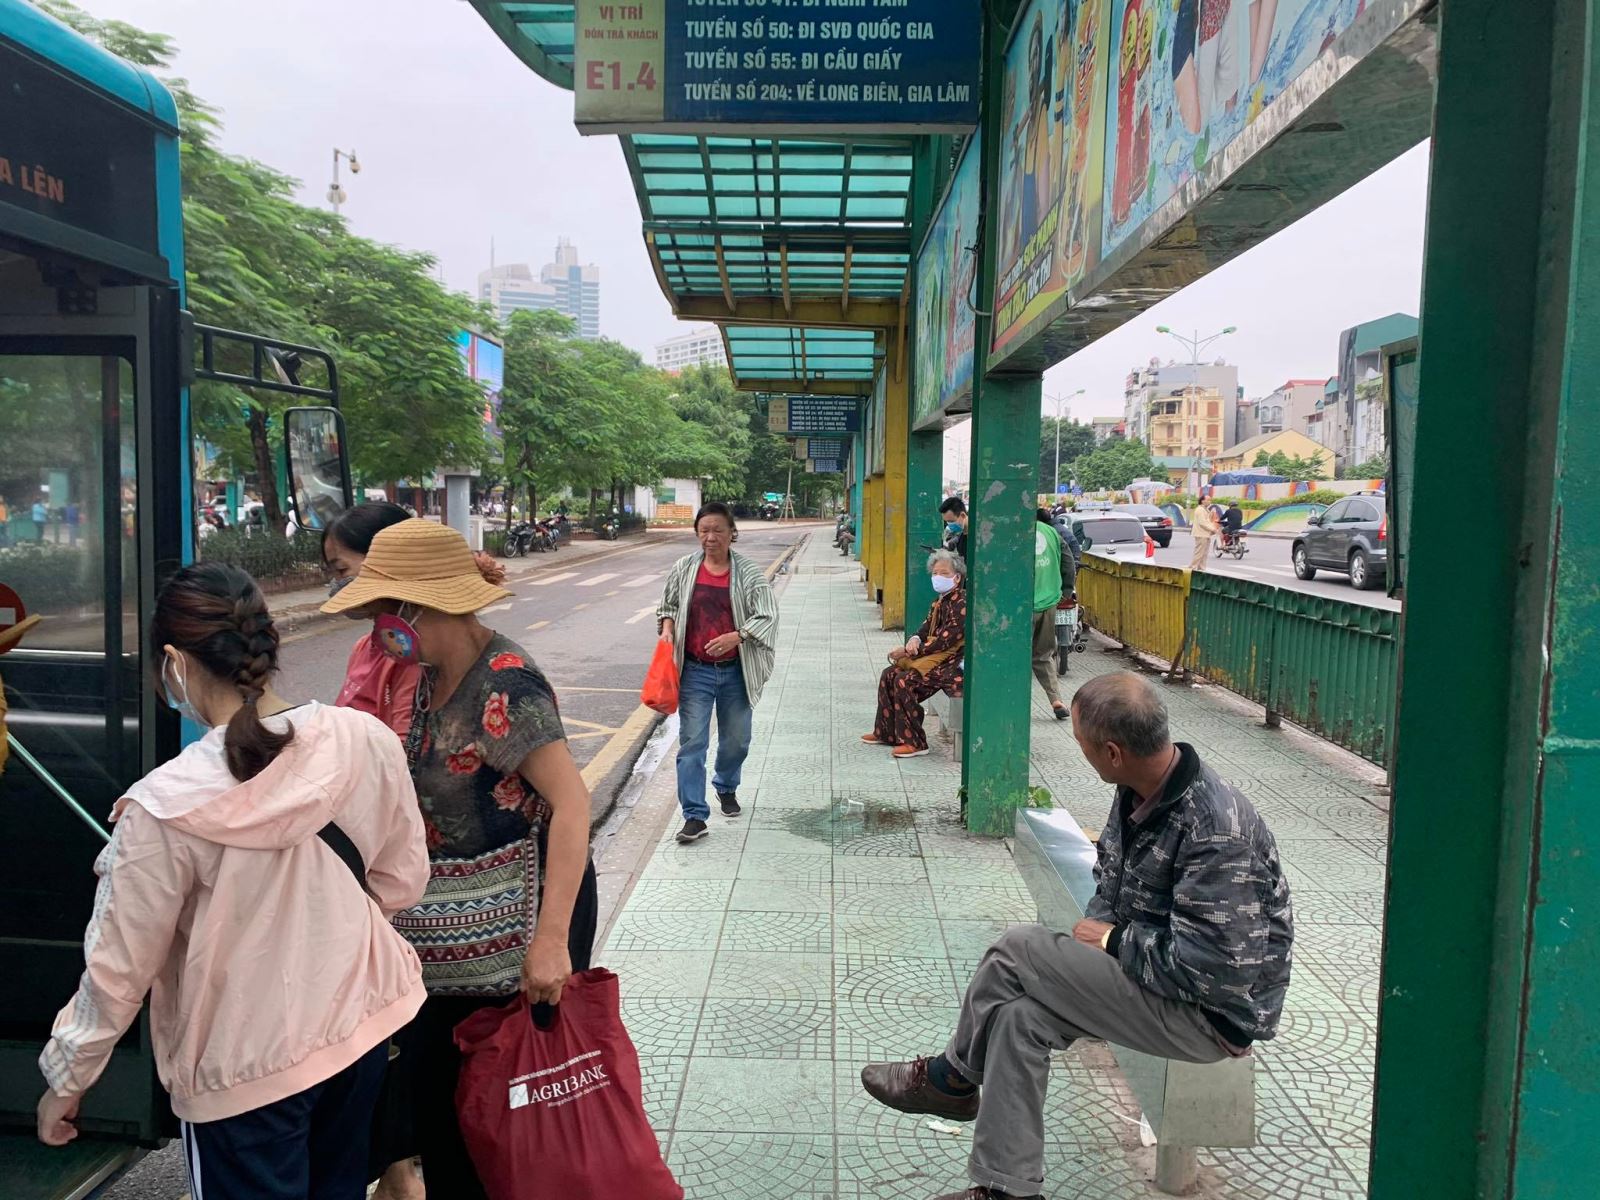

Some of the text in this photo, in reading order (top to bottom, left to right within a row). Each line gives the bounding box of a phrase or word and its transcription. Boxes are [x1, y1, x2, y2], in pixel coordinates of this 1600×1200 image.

[599, 3, 643, 23] VỊ TRÍ
[627, 28, 659, 40] KHÁCH
[685, 15, 934, 41] TUYẾN SỐ 50: ĐI SVĐ QUỐC GIA
[684, 45, 903, 70] TUYẾN SỐ 55: ĐI CẦU GIẤY
[586, 60, 657, 91] E1.4
[684, 77, 970, 105] TUYẾN SỐ 204: VỀ LONG BIÊN, GIA LÂM
[20, 164, 65, 203] LÊN
